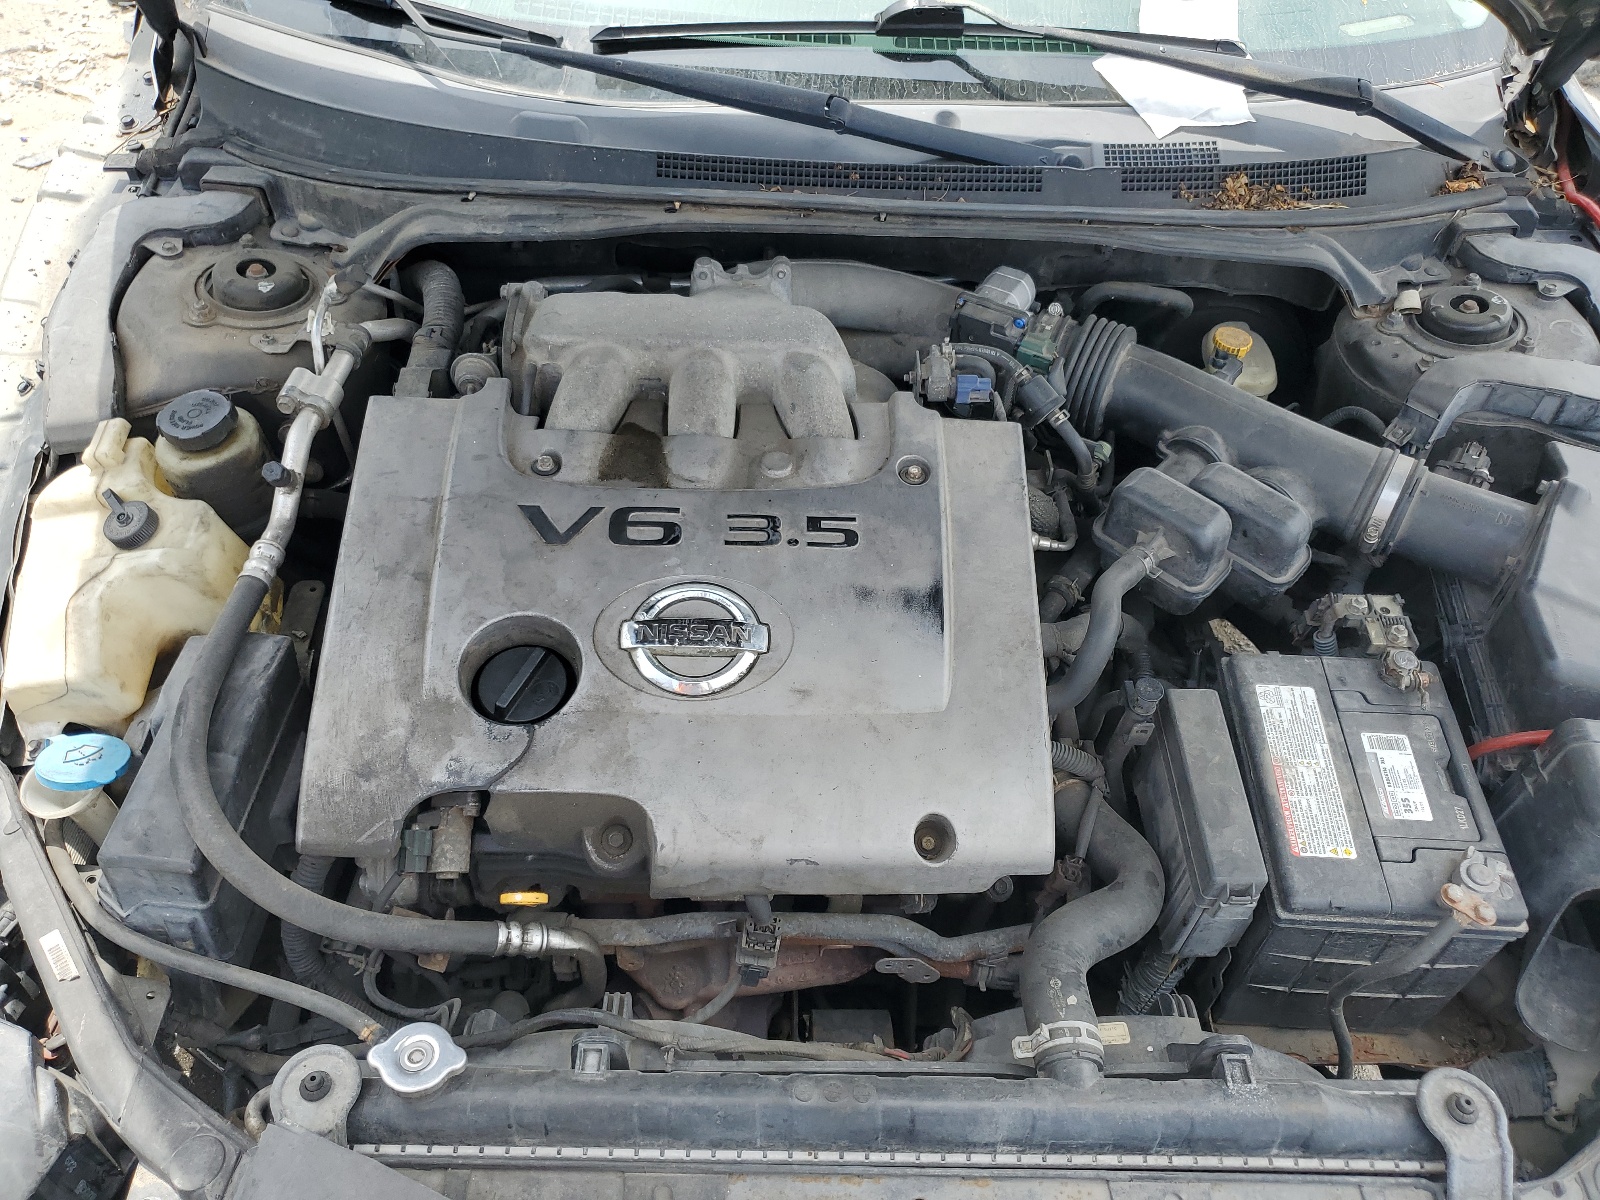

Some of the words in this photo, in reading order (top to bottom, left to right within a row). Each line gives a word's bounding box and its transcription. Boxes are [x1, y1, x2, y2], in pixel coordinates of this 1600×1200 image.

[517, 504, 682, 546] V6
[724, 513, 860, 547] 3.5
[636, 622, 752, 644] NISSAN
[1401, 797, 1413, 814] 355
